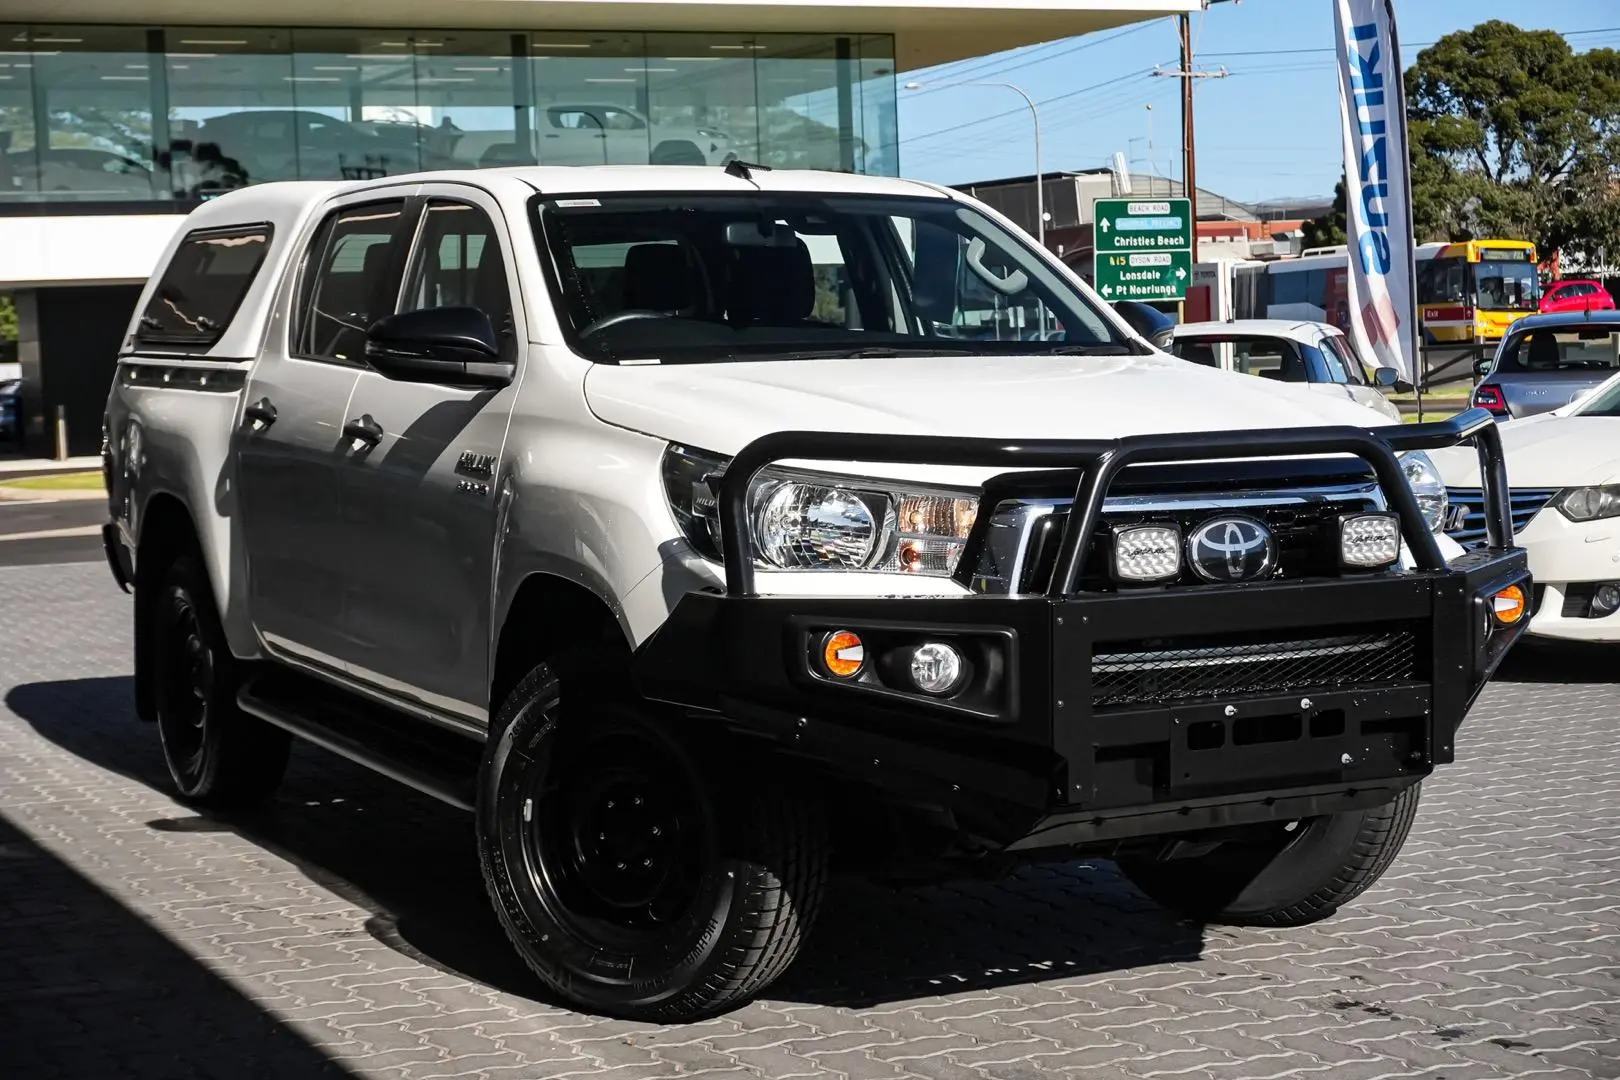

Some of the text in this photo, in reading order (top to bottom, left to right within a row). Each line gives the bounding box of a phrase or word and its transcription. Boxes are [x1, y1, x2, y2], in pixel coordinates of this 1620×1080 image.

[1152, 204, 1169, 212] ROAD
[1114, 235, 1184, 246] Christies Beach
[1153, 255, 1170, 263] ROAD
[1120, 270, 1160, 280] Lonsdale
[1116, 285, 1176, 296] Pt Noarlunga
[696, 497, 716, 506] HILU
